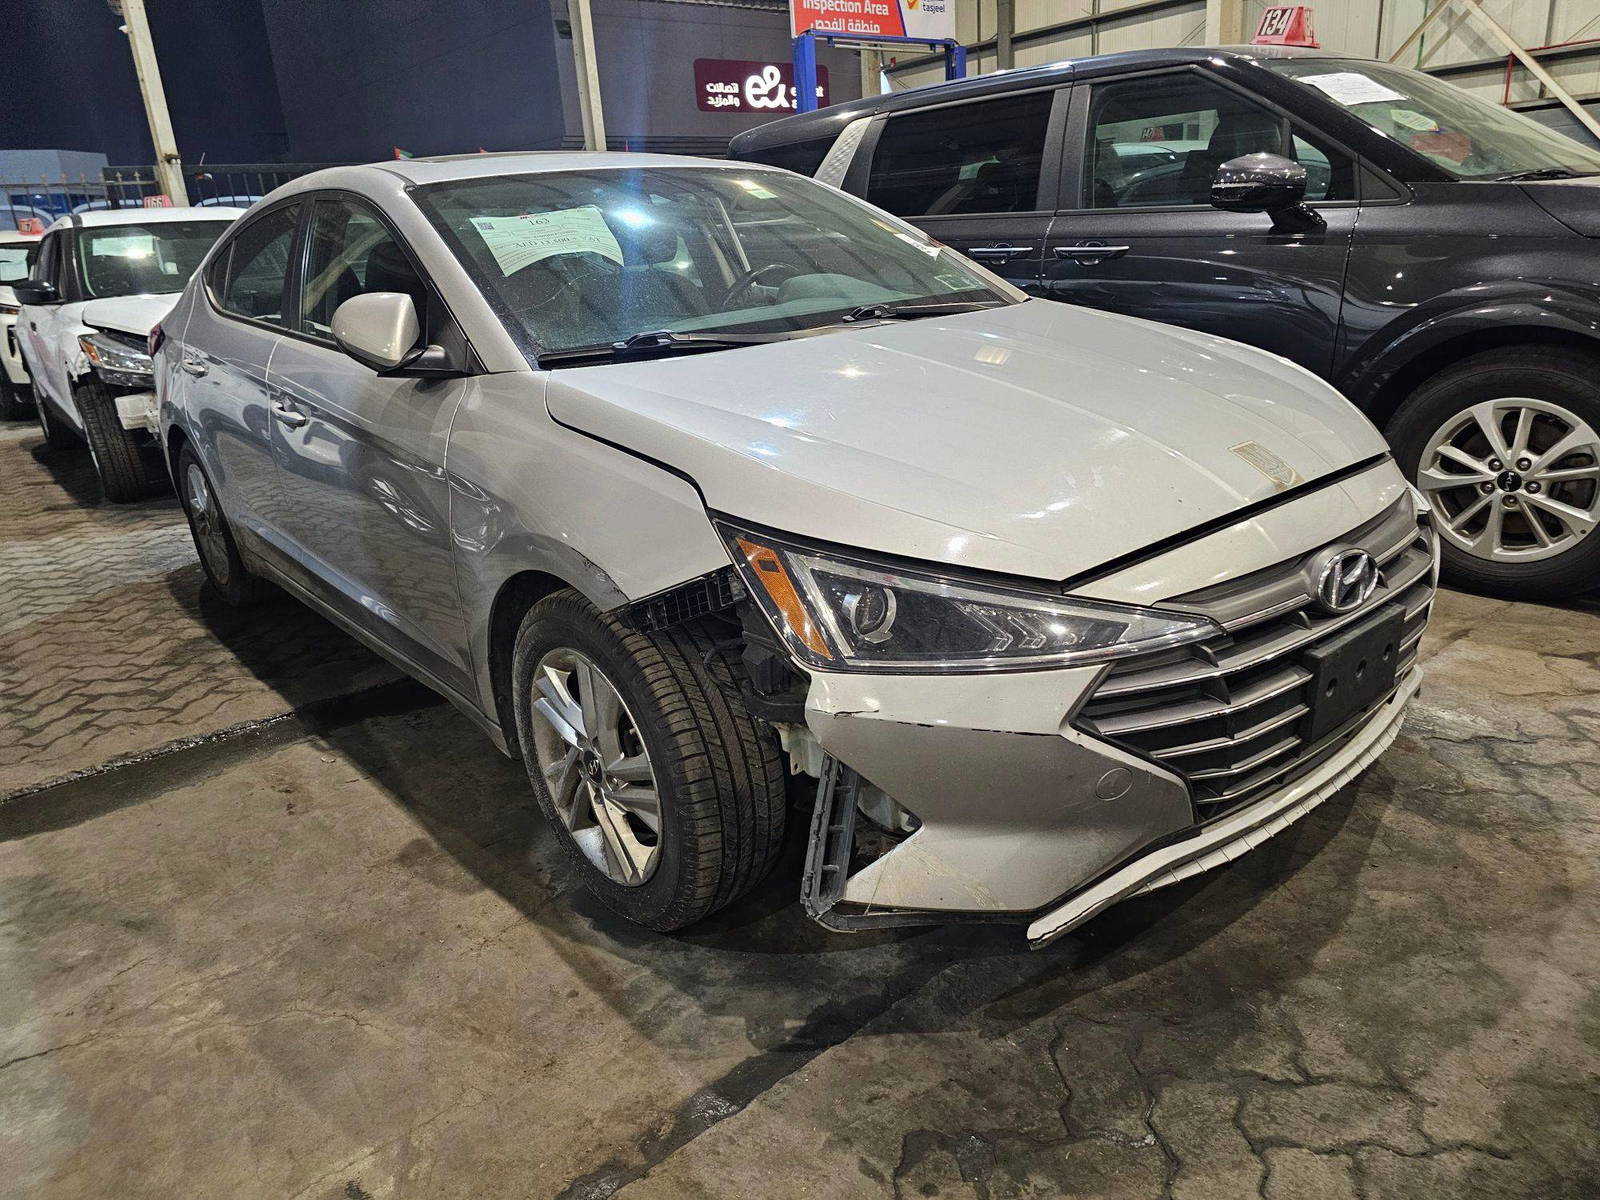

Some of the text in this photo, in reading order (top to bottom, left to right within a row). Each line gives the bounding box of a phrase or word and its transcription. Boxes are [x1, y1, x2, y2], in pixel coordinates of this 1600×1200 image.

[803, 0, 889, 16] Inspection Area
[923, 4, 946, 14] tasjeel
[811, 18, 881, 34] منطقة الفحص
[1260, 8, 1292, 36] 134
[707, 94, 741, 107] والمزيد
[529, 217, 551, 227] 163
